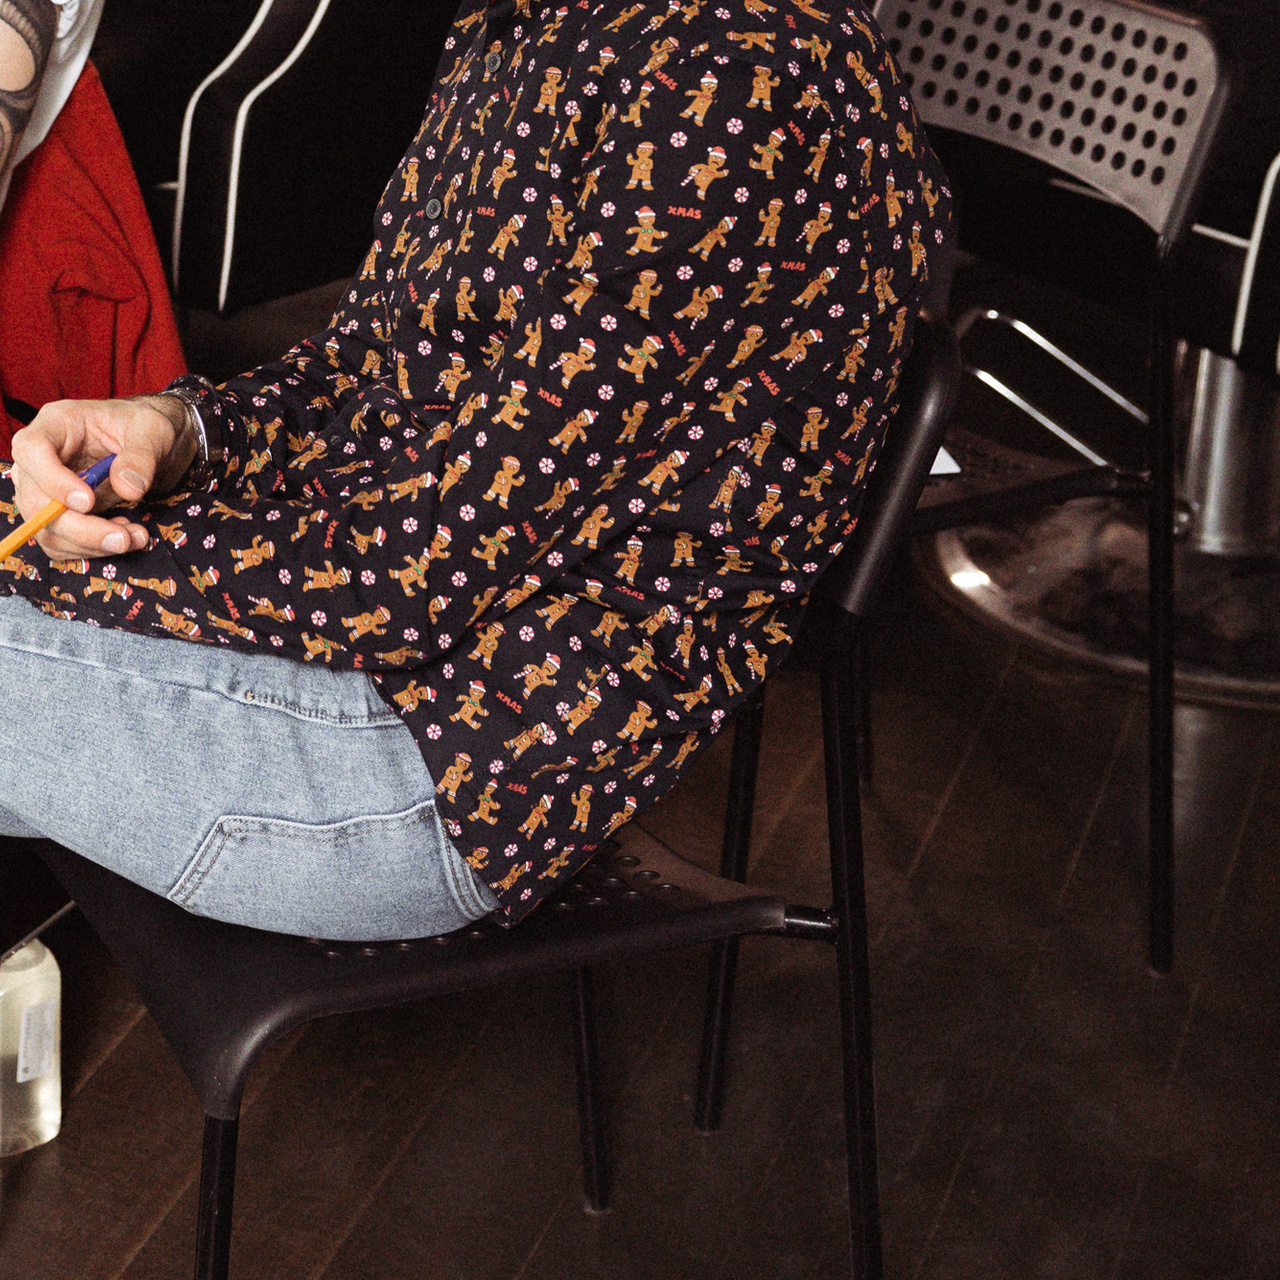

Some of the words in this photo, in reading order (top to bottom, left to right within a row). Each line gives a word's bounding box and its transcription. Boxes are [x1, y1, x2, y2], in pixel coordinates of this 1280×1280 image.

[654, 69, 678, 90] XMAS
[788, 121, 805, 146] XMAS
[477, 206, 495, 217] XMAS
[667, 205, 702, 220] XMAS
[781, 261, 806, 271] XMAS
[668, 331, 686, 356] XMAS
[757, 370, 780, 396] XMAS
[537, 387, 562, 408] XMAS
[835, 450, 851, 465] XMAS
[324, 519, 339, 548] XMAS
[522, 521, 537, 544] XMAS
[615, 586, 645, 600] XMAS
[222, 592, 240, 620] XMAS
[496, 690, 522, 714] XMAS
